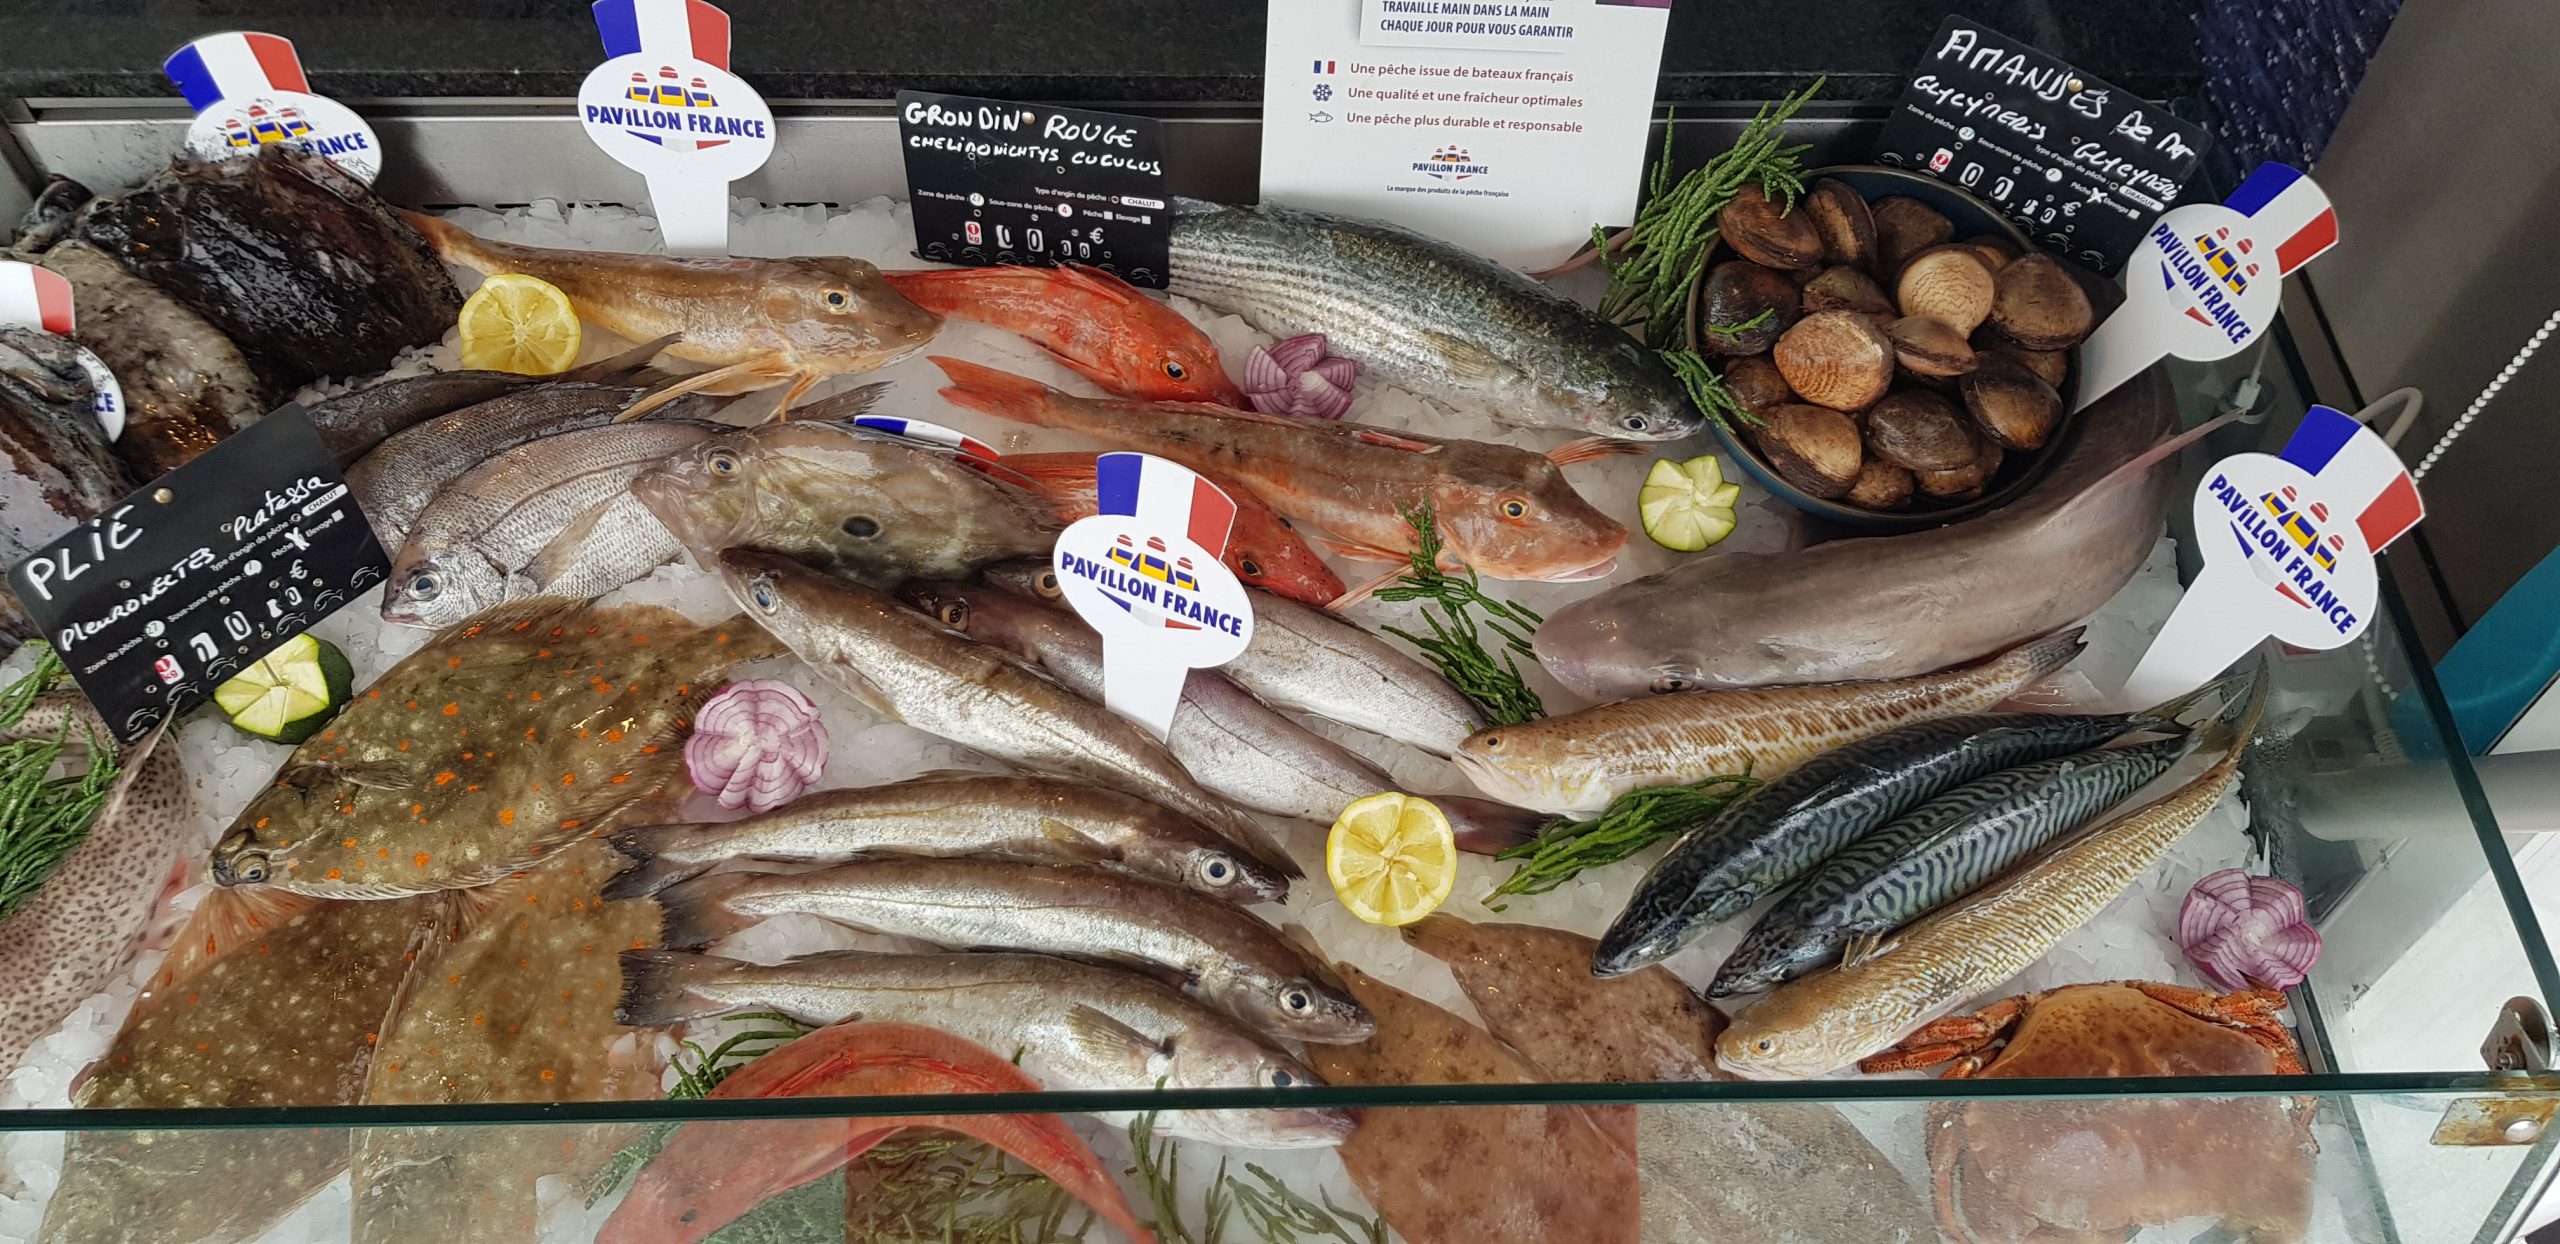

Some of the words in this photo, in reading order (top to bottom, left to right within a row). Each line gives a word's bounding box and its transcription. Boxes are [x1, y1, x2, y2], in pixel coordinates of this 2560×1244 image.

[1382, 1, 1439, 14] TRAVAILLE
[1441, 3, 1471, 15] MAIN
[1473, 4, 1502, 16] DANS
[1505, 5, 1518, 17] LA
[1520, 6, 1550, 18] MAIN
[1380, 19, 1424, 32] CHAQUE
[1425, 21, 1453, 33] JOUR
[1456, 22, 1486, 34] POUR
[1488, 23, 1516, 35] VOUS
[1519, 24, 1573, 38] GARANTIR
[1350, 62, 1376, 74] Une
[1378, 64, 1416, 77] pêche
[1419, 65, 1451, 77] issue
[1453, 66, 1469, 78] de
[1472, 67, 1522, 79] bateaux
[1525, 69, 1574, 84] français
[1348, 87, 1373, 99] Une
[1376, 89, 1419, 102] qualité
[1422, 91, 1434, 101] et
[1437, 92, 1461, 102] une
[1464, 91, 1519, 105] fraîcheur
[1522, 95, 1584, 108] optimales
[586, 104, 682, 131] PAVILLON
[688, 113, 766, 140] FRANCE
[1044, 114, 1138, 148] ROUGE
[1347, 112, 1371, 124] Une
[1374, 114, 1411, 127] pêche
[1414, 115, 1440, 128] plus
[1443, 116, 1490, 129] durable
[1493, 119, 1506, 129] et
[1508, 120, 1583, 133] responsable
[1906, 103, 1926, 117] Zone
[1924, 111, 1936, 122] de
[1934, 117, 1957, 131] pêche
[1961, 129, 1974, 139] 27
[1977, 136, 2013, 158] Sous-zone
[2012, 153, 2023, 163] de
[2021, 157, 2044, 173] pêche
[1412, 162, 1453, 173] PAVILLON
[1455, 164, 1489, 175] FRANCE
[2034, 144, 2051, 156] Type
[2050, 150, 2076, 169] d'engin
[2075, 164, 2086, 174] de
[2084, 169, 2107, 184] pêche
[1035, 186, 1050, 196] Type
[1051, 189, 1076, 199] d'engin
[1076, 192, 1086, 200] de
[1086, 193, 1107, 203] pêche
[1127, 198, 1157, 208] CHALUT
[1394, 186, 1416, 194] marque
[1417, 185, 1427, 194] des
[1427, 186, 1451, 195] produits
[1451, 187, 1459, 195] de
[1466, 188, 1483, 197] pêche
[1484, 189, 1509, 199] française
[2070, 181, 2093, 196] Pêche
[917, 188, 935, 198] Zone
[935, 190, 945, 199] de
[945, 192, 965, 202] pêche
[989, 198, 1022, 209] Sous-zone
[1023, 200, 1033, 210] de
[1033, 203, 1054, 213] pêche
[2062, 202, 2082, 217] €
[1082, 209, 1104, 219] Pêche
[968, 234, 980, 243] kg
[1089, 227, 1104, 244] €
[2150, 222, 2210, 292] PAVILLON
[2199, 284, 2252, 345] FRANCE
[209, 558, 229, 573] Type
[228, 542, 257, 561] d'engin
[255, 535, 267, 545] de
[266, 521, 289, 539] pêche
[308, 490, 338, 512] CHALUT
[270, 541, 294, 559] Pêche
[2208, 473, 2292, 563] PAVILLON
[2285, 555, 2358, 635] FRANCE
[289, 558, 308, 580] €
[1061, 551, 1157, 604] PAVILLON
[1163, 589, 1243, 638] FRANCE
[83, 657, 108, 674] Zone
[106, 651, 119, 661] de
[117, 636, 143, 656] pêche
[167, 595, 208, 623] Sous-zone
[206, 588, 219, 599] de
[217, 575, 242, 594] pêche
[161, 669, 178, 681] kg
